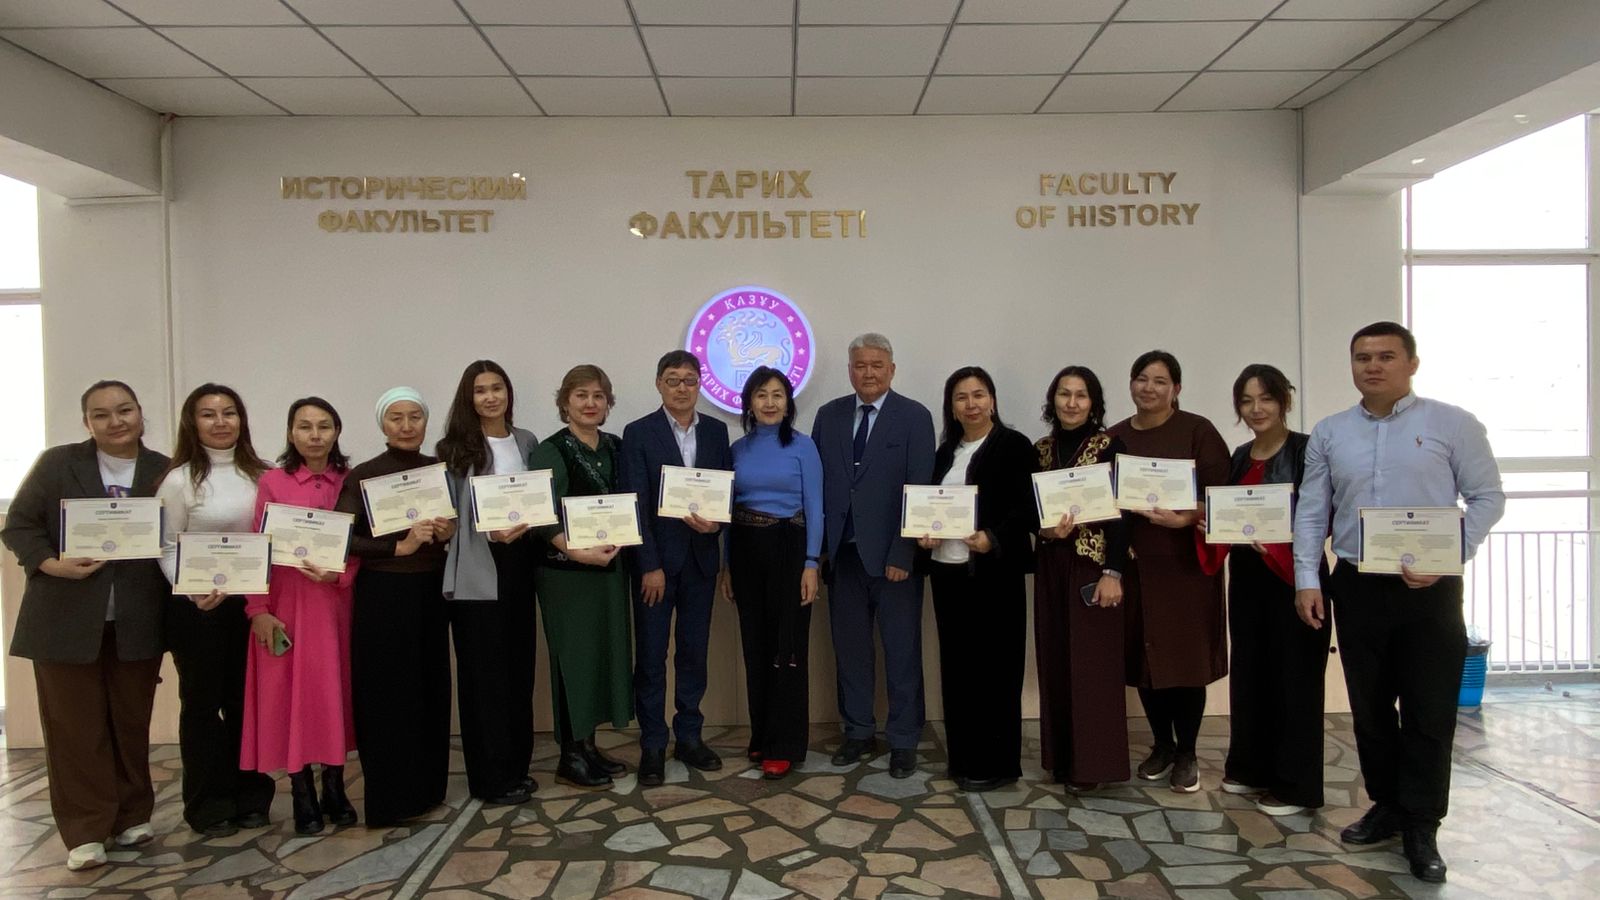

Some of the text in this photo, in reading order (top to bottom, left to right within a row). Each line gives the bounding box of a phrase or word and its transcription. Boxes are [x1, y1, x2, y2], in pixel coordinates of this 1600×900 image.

[281, 173, 528, 200] ИСТОРИЧЕСКИЙ
[685, 169, 812, 199] ТАРИХ
[1039, 172, 1177, 196] FACULTY
[317, 209, 494, 234] ФАКУЛЬТЕТ
[628, 210, 867, 240] ФАКУЛЬТЕТІ
[1015, 203, 1200, 228] OF HISTORY
[700, 364, 730, 400] ТАРИХ
